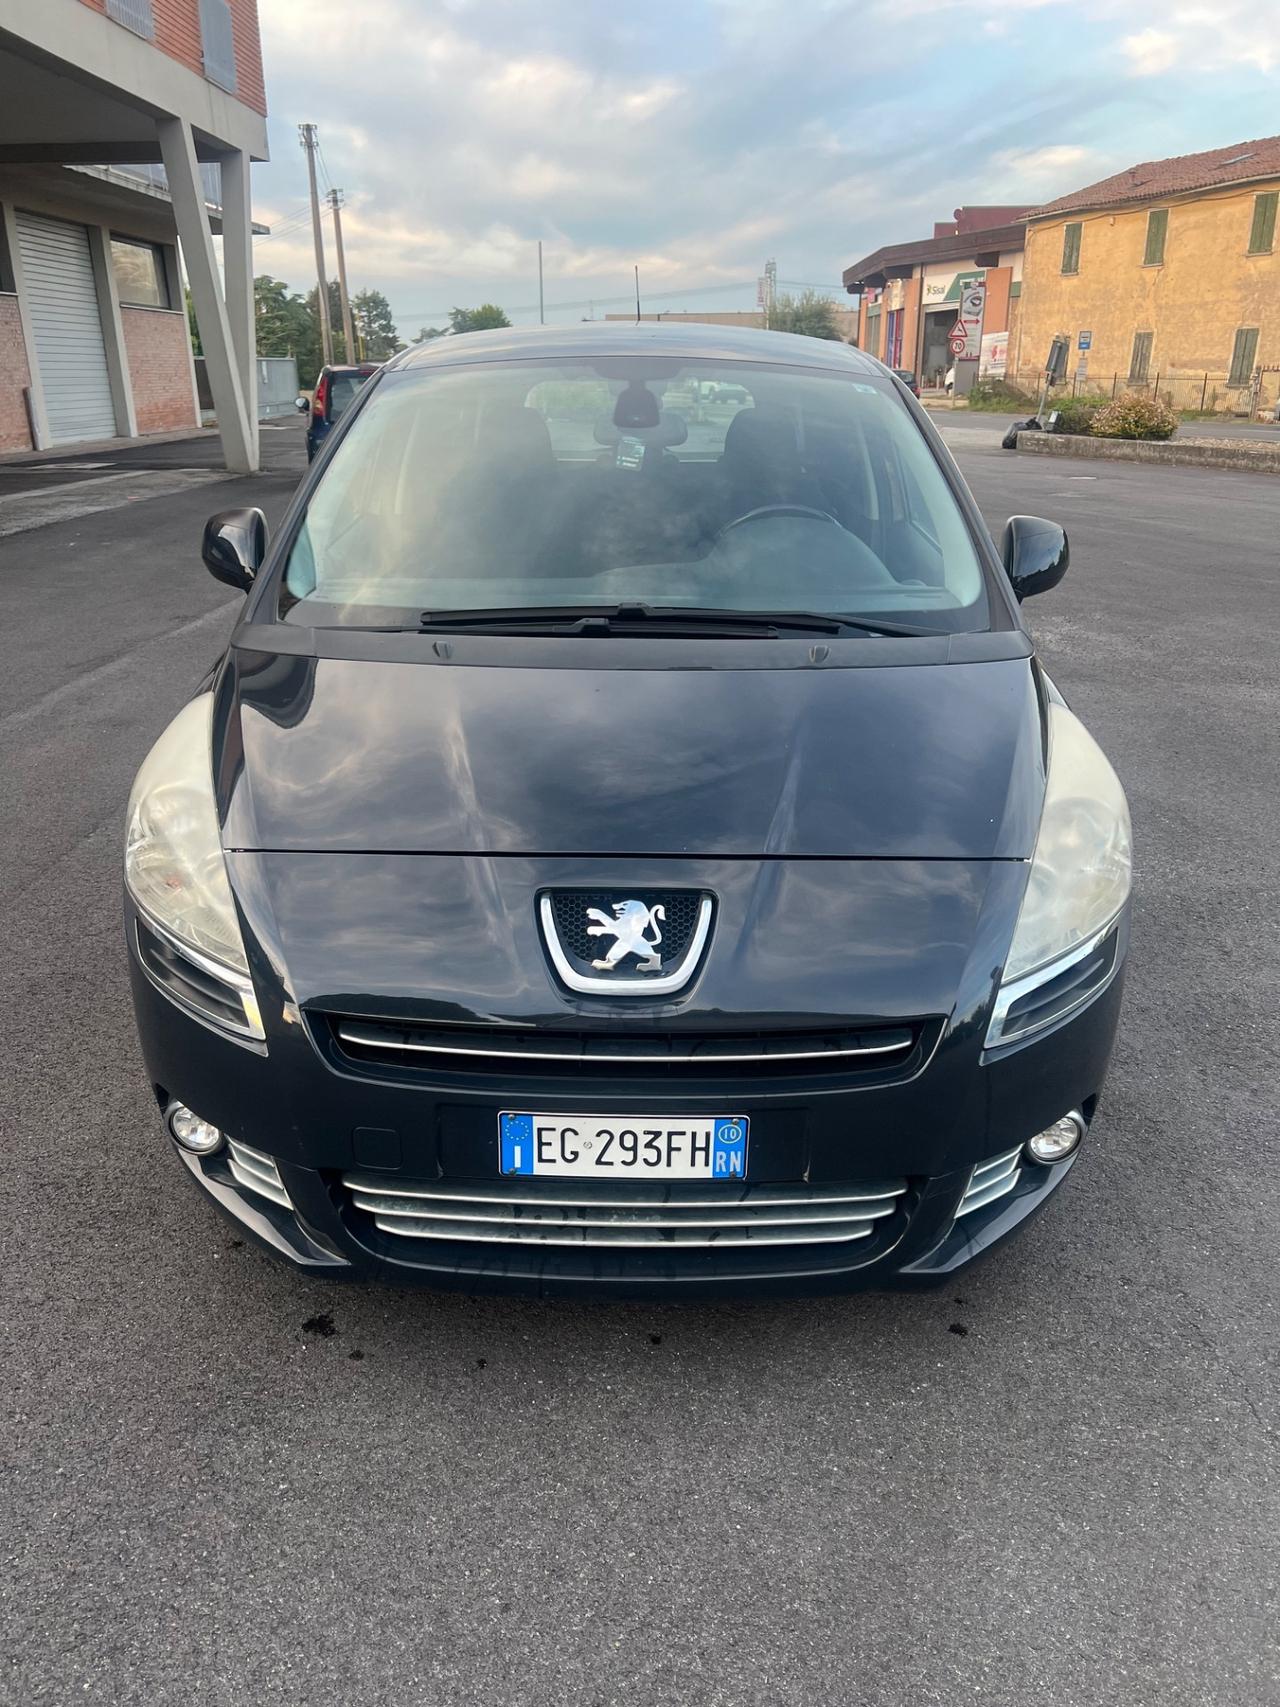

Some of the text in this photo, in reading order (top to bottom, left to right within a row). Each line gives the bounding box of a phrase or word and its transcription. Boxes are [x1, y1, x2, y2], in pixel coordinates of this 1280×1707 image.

[932, 285, 946, 295] Sisal
[722, 1128, 739, 1140] 10
[514, 1145, 522, 1168] I
[536, 1127, 712, 1168] EG 293FH
[715, 1150, 742, 1173] RN
